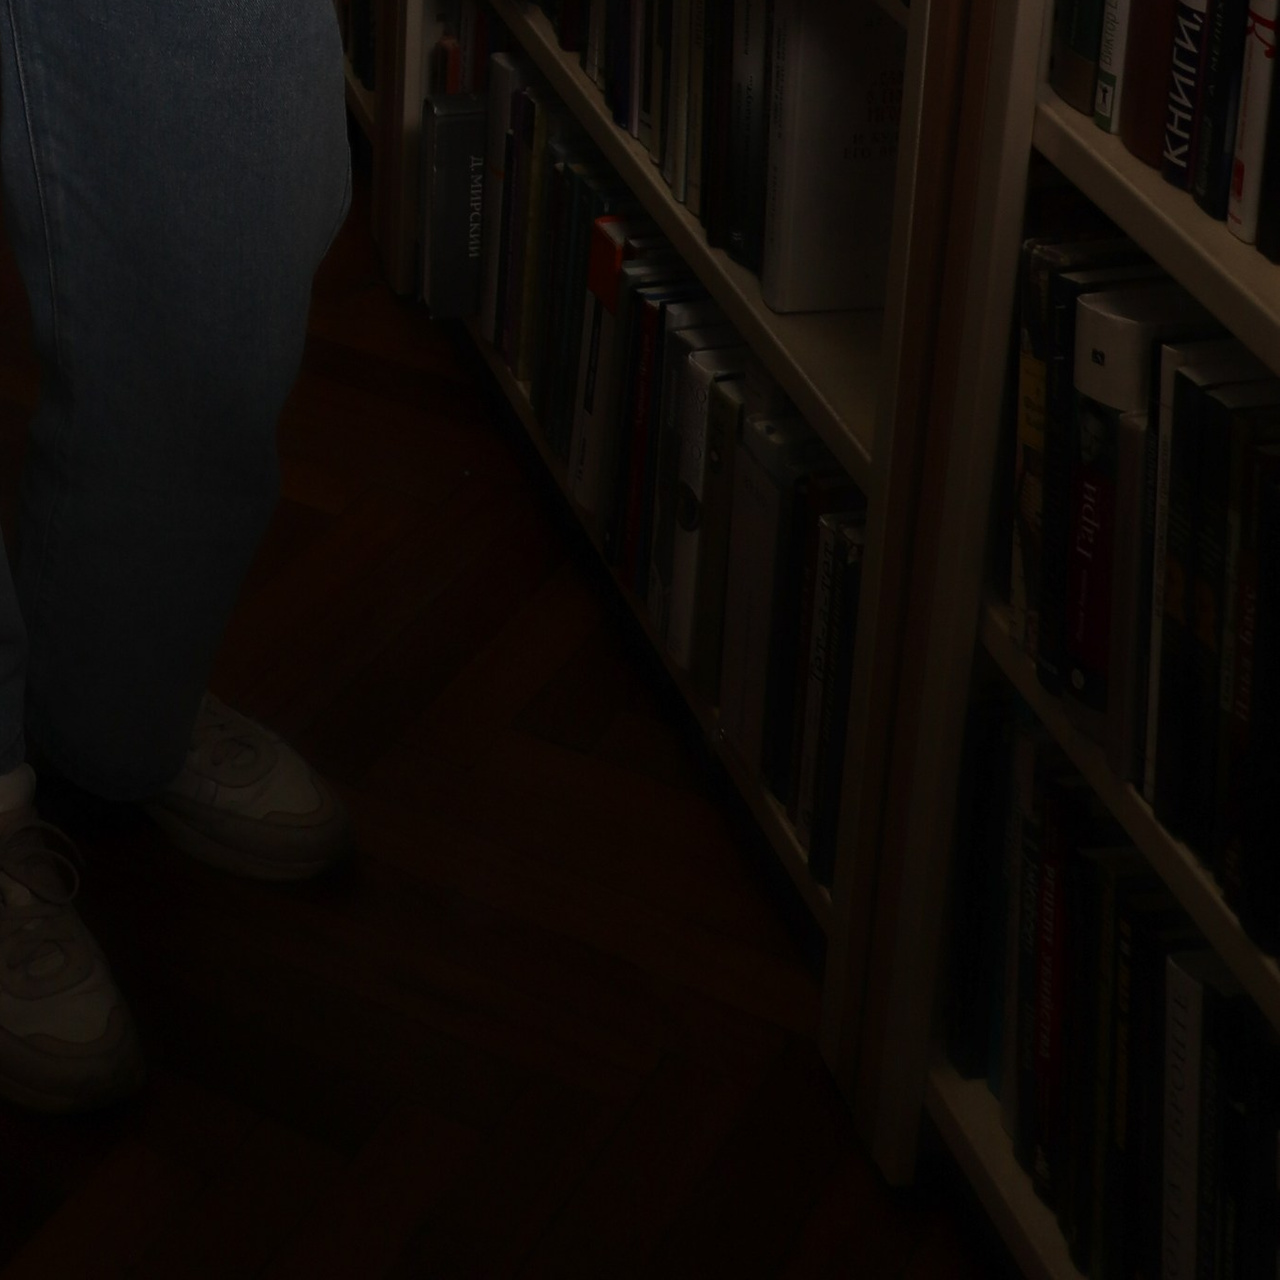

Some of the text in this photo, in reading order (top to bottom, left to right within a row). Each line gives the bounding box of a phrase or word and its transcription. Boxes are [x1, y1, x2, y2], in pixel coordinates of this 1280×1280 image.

[1100, 12, 1118, 67] Виктор
[1162, 12, 1206, 168] КНИГИ,
[470, 155, 484, 171] Д.
[1075, 480, 1101, 563] Гари
